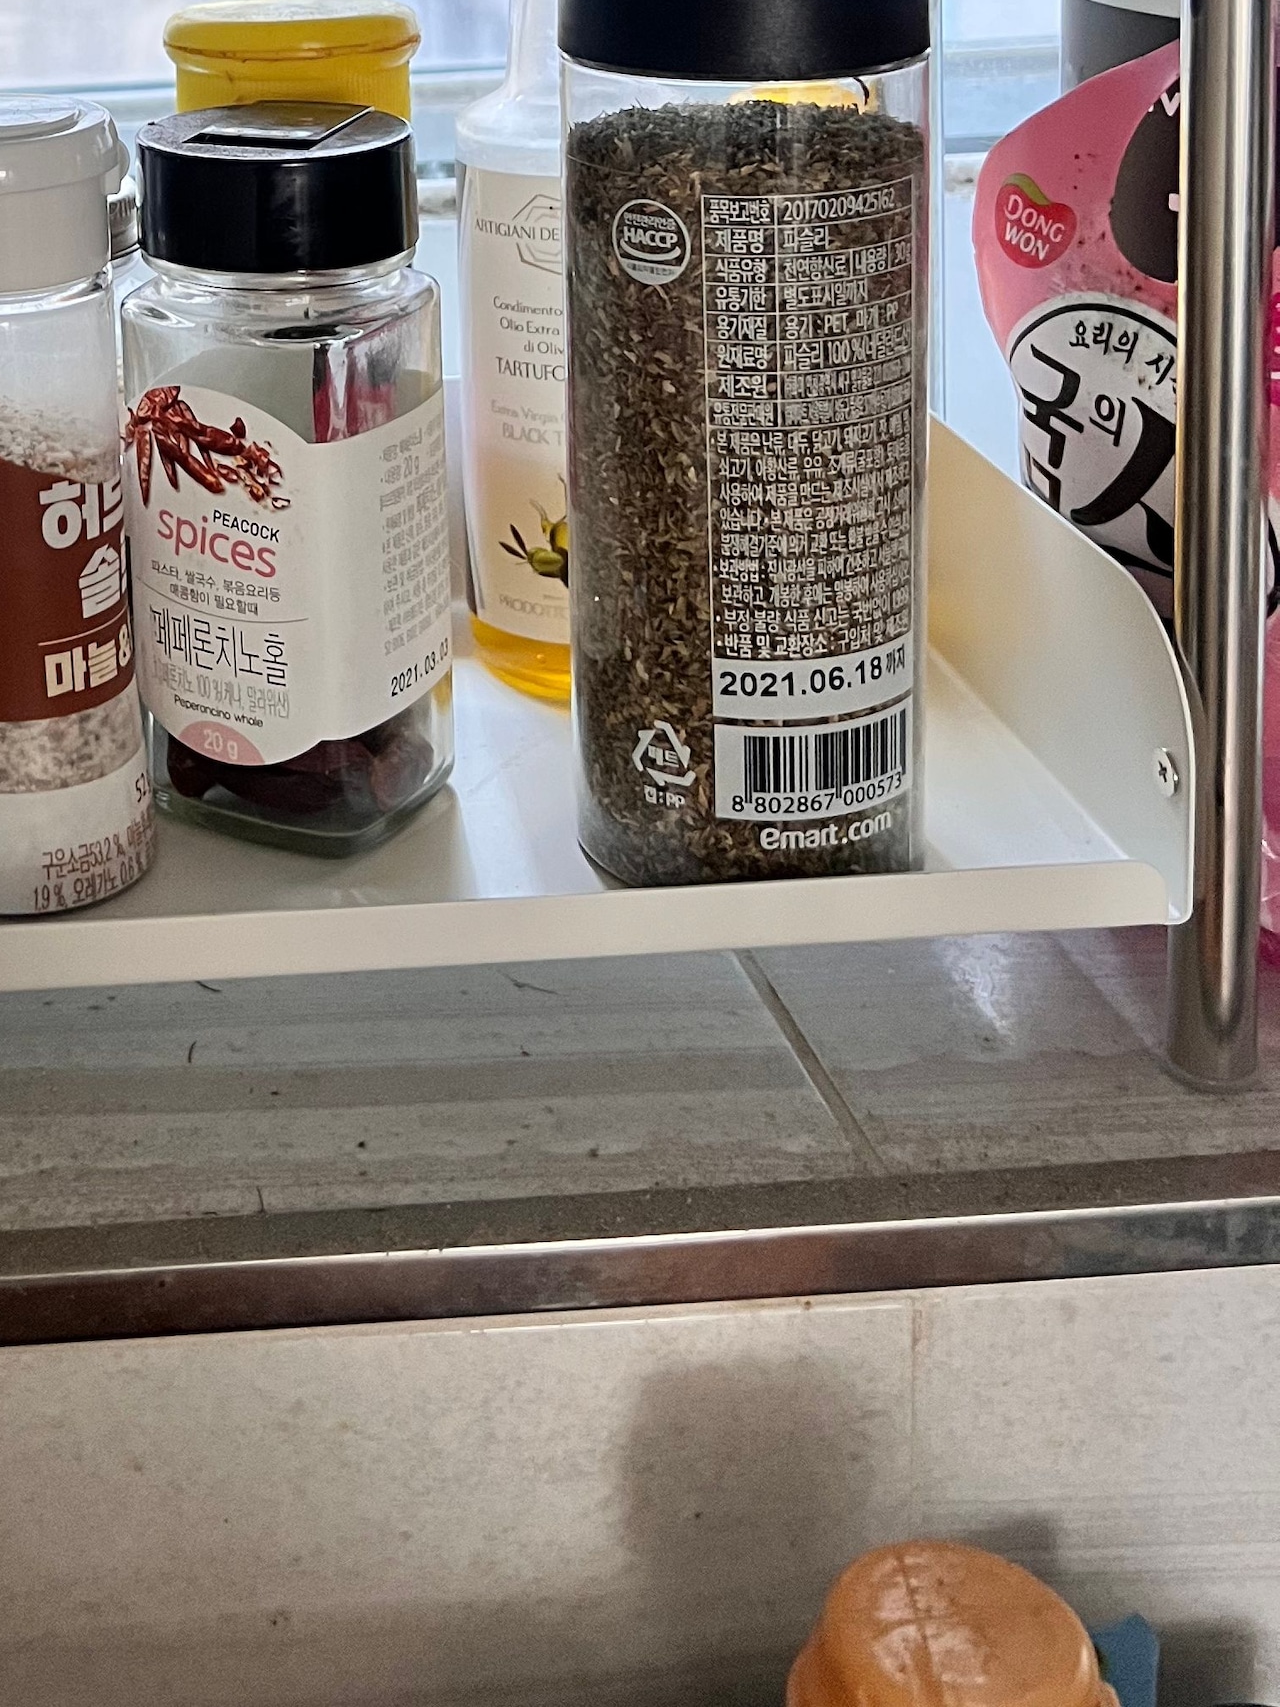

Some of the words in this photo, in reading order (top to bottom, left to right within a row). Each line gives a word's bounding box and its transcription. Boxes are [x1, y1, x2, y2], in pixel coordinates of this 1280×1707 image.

[709, 199, 770, 223] 품목보고번호
[1004, 194, 1064, 243] DONG
[475, 218, 535, 240] ARTIGIANI
[540, 227, 560, 241] DE
[623, 226, 677, 248] HACCP
[716, 229, 764, 253] 제품명
[784, 226, 829, 252] 파슬리
[1005, 223, 1049, 260] WON
[716, 258, 766, 282] 식품유형
[855, 246, 886, 272] 내용량
[493, 296, 563, 316] Condimento
[716, 287, 766, 311] 유통기한
[500, 317, 524, 332] Olio
[527, 321, 560, 335] Extra
[717, 315, 767, 339] 용기재질
[524, 341, 534, 352] di
[538, 342, 564, 355] Oliv
[717, 344, 768, 369] 원재료명
[784, 342, 823, 369] 파슬리
[1070, 320, 1139, 364] 요리의
[1145, 353, 1177, 394] 시
[719, 375, 767, 398] 제조원
[503, 423, 549, 443] BLACK
[213, 510, 280, 542] PEACOCK
[157, 509, 276, 578] spices
[79, 532, 127, 618] 솔
[785, 609, 810, 633] 식품
[150, 605, 288, 687] 페페론치노홀
[725, 633, 753, 658] 반품
[756, 633, 770, 658] 및
[775, 633, 827, 656] 교환장소
[720, 656, 882, 696] 2021.06.18
[732, 796, 744, 812] 8
[754, 795, 833, 813] 802867
[843, 772, 902, 806] 000573
[760, 812, 892, 850] emart.com
